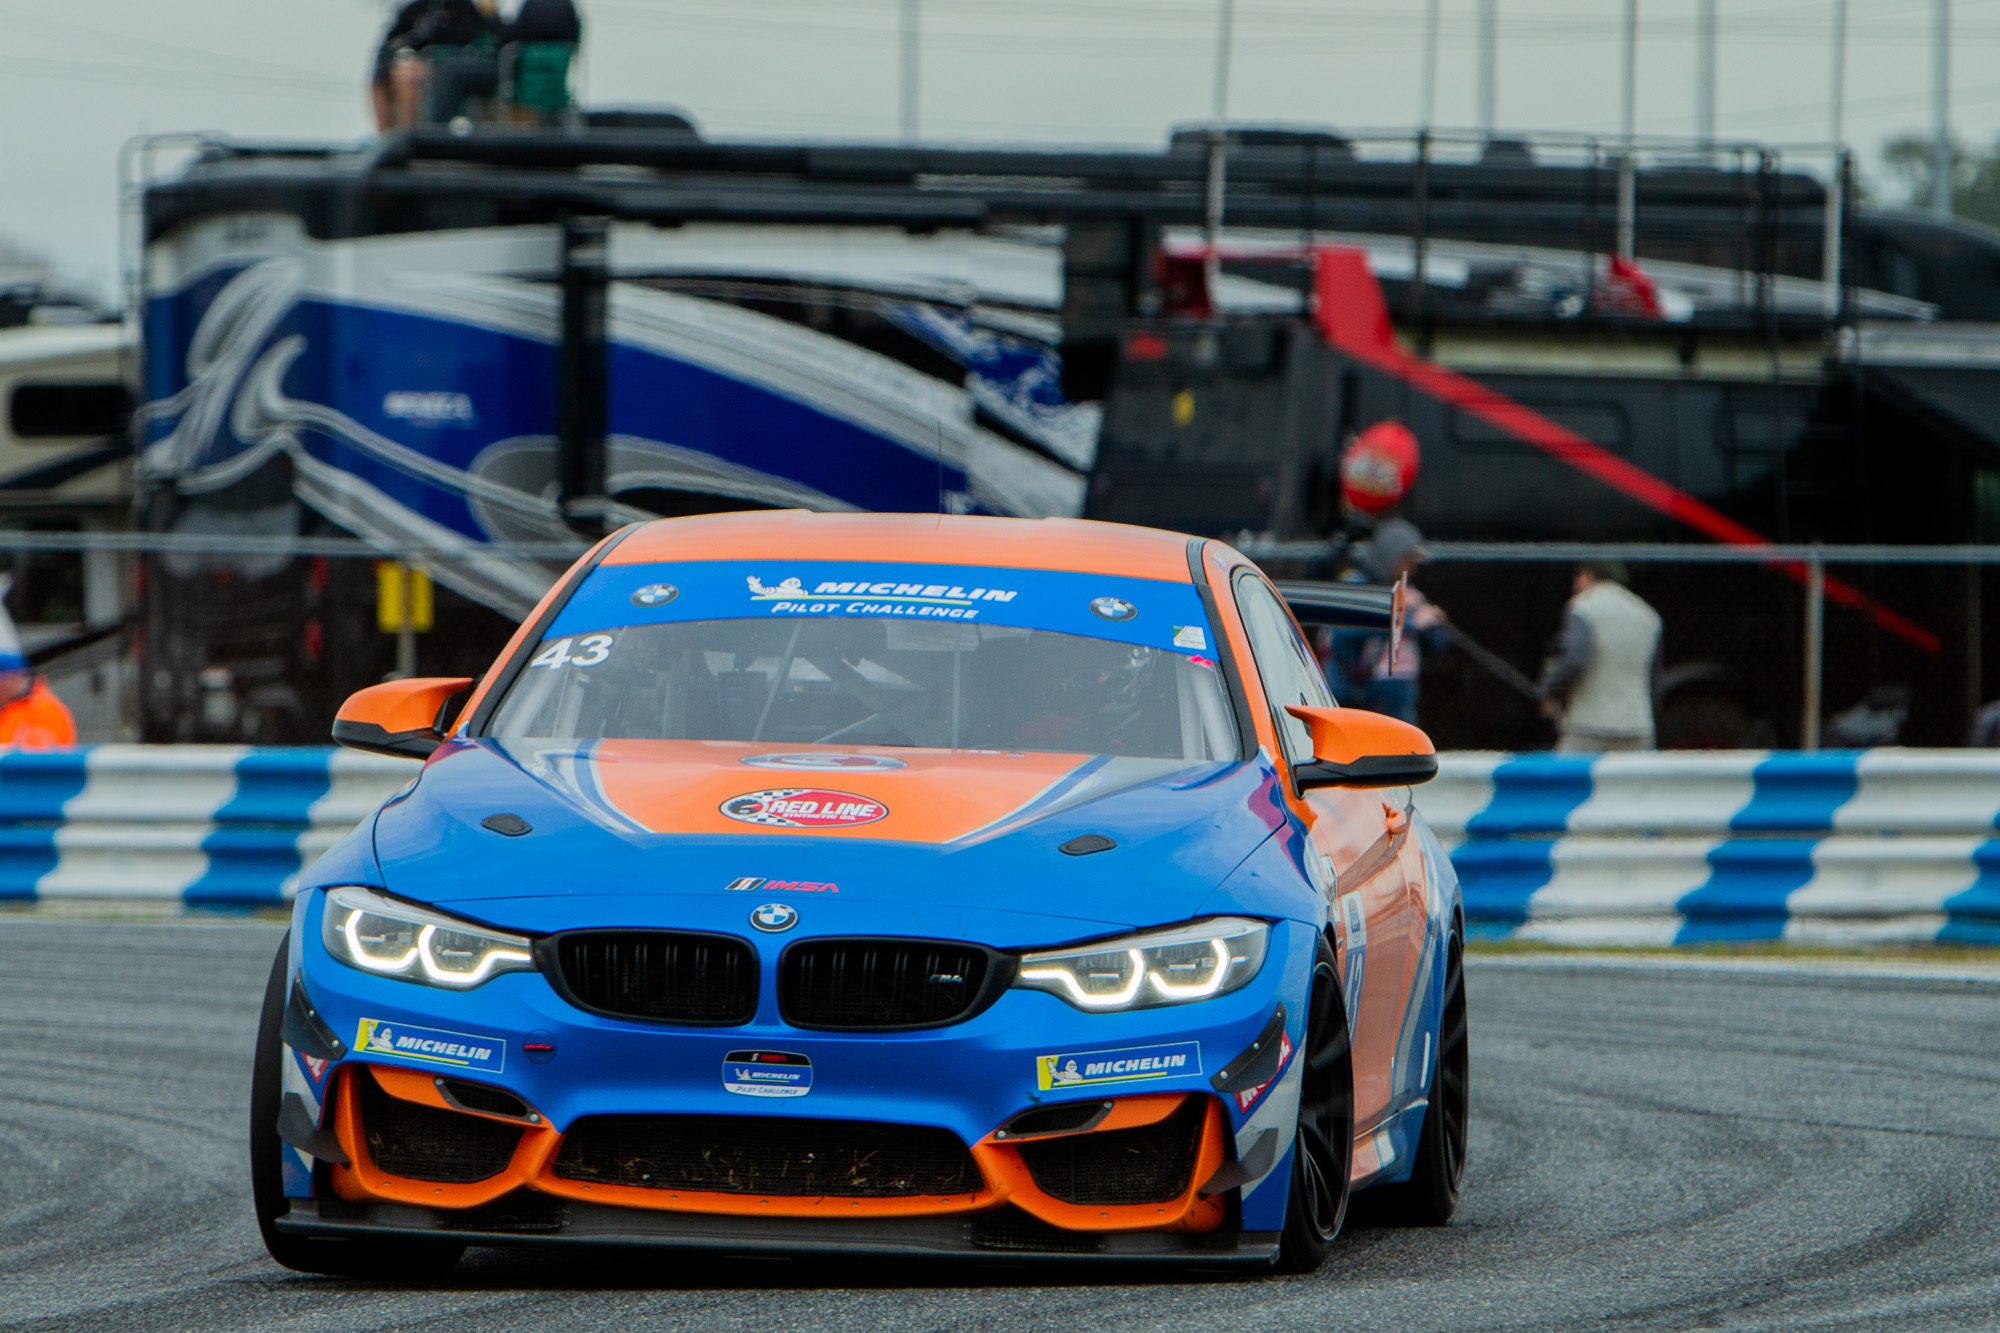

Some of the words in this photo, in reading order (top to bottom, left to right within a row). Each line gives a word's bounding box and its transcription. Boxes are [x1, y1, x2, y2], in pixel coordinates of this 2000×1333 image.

[814, 581, 1018, 603] MICHELIN
[771, 602, 840, 614] PILOT
[846, 602, 979, 619] CHALLENGE
[531, 634, 613, 670] 43
[768, 800, 819, 814] RED
[821, 801, 878, 817] LINE
[762, 880, 839, 893] IMSA
[396, 1036, 492, 1061] MICHELIN
[1085, 1054, 1187, 1076] MICHELIN
[751, 1071, 800, 1080] MICHELIN
